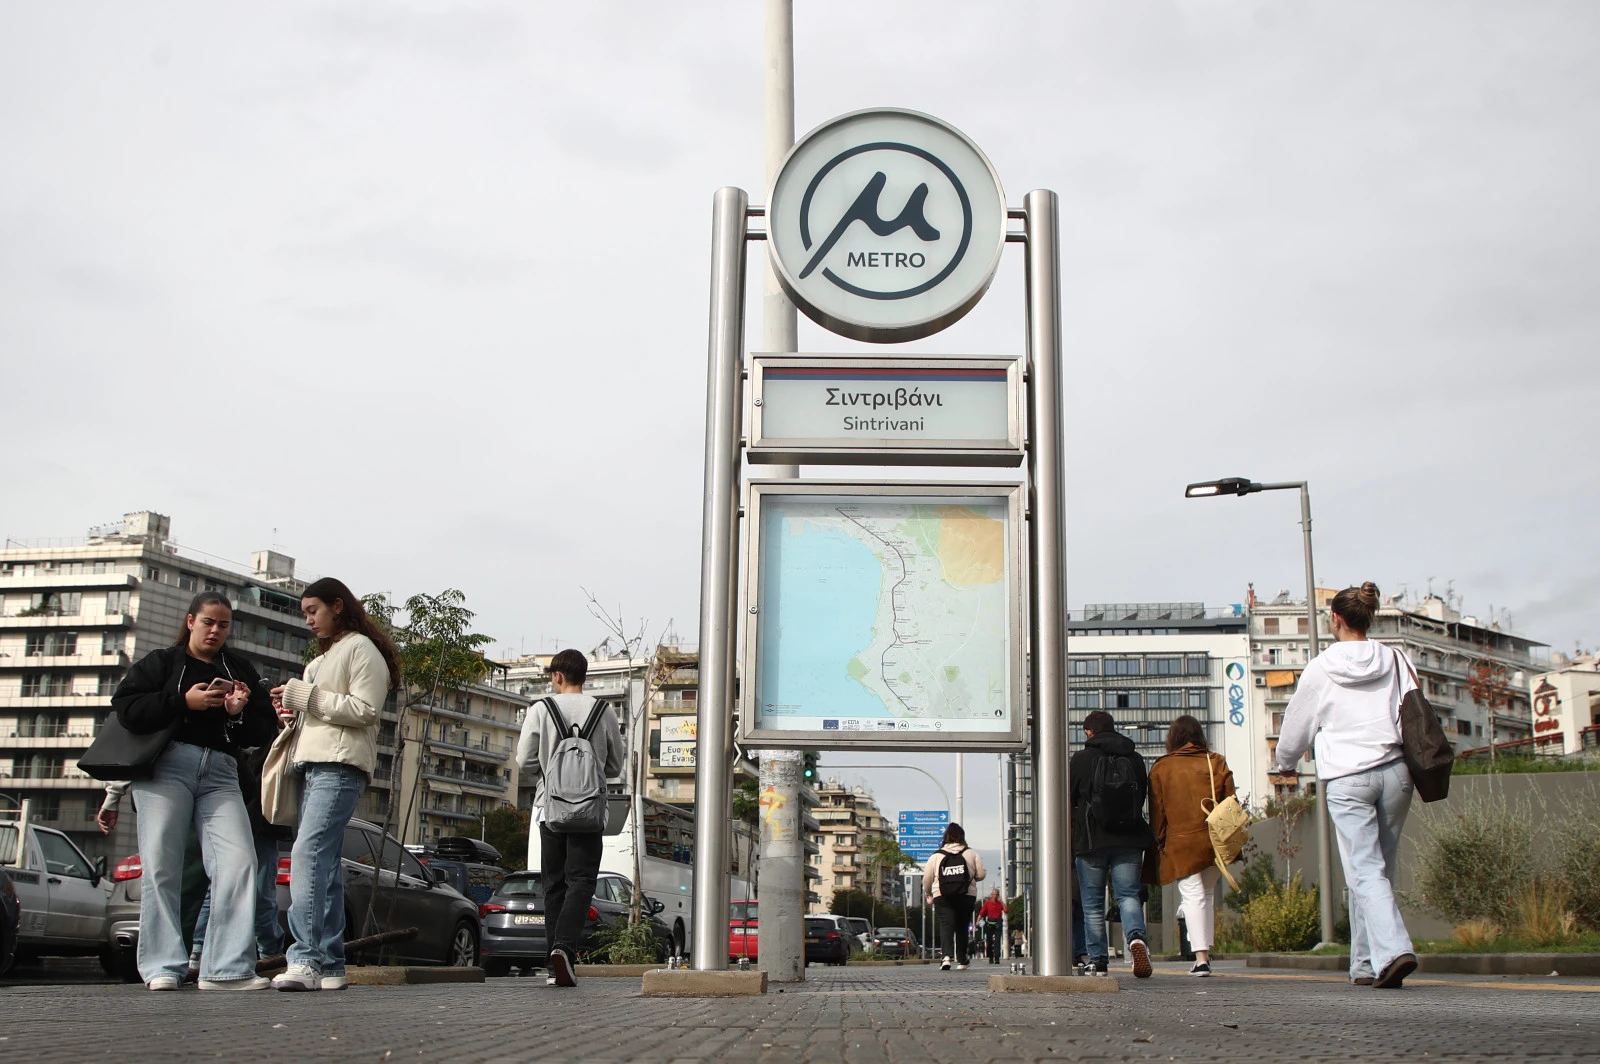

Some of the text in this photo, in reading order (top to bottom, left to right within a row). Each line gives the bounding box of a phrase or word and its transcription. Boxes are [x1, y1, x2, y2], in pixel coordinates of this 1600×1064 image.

[847, 252, 926, 268] METRO
[825, 387, 943, 410] Σιντριβάνι
[843, 416, 924, 431] Sintrivani
[672, 755, 696, 763] Evang
[942, 865, 964, 875] VANS
